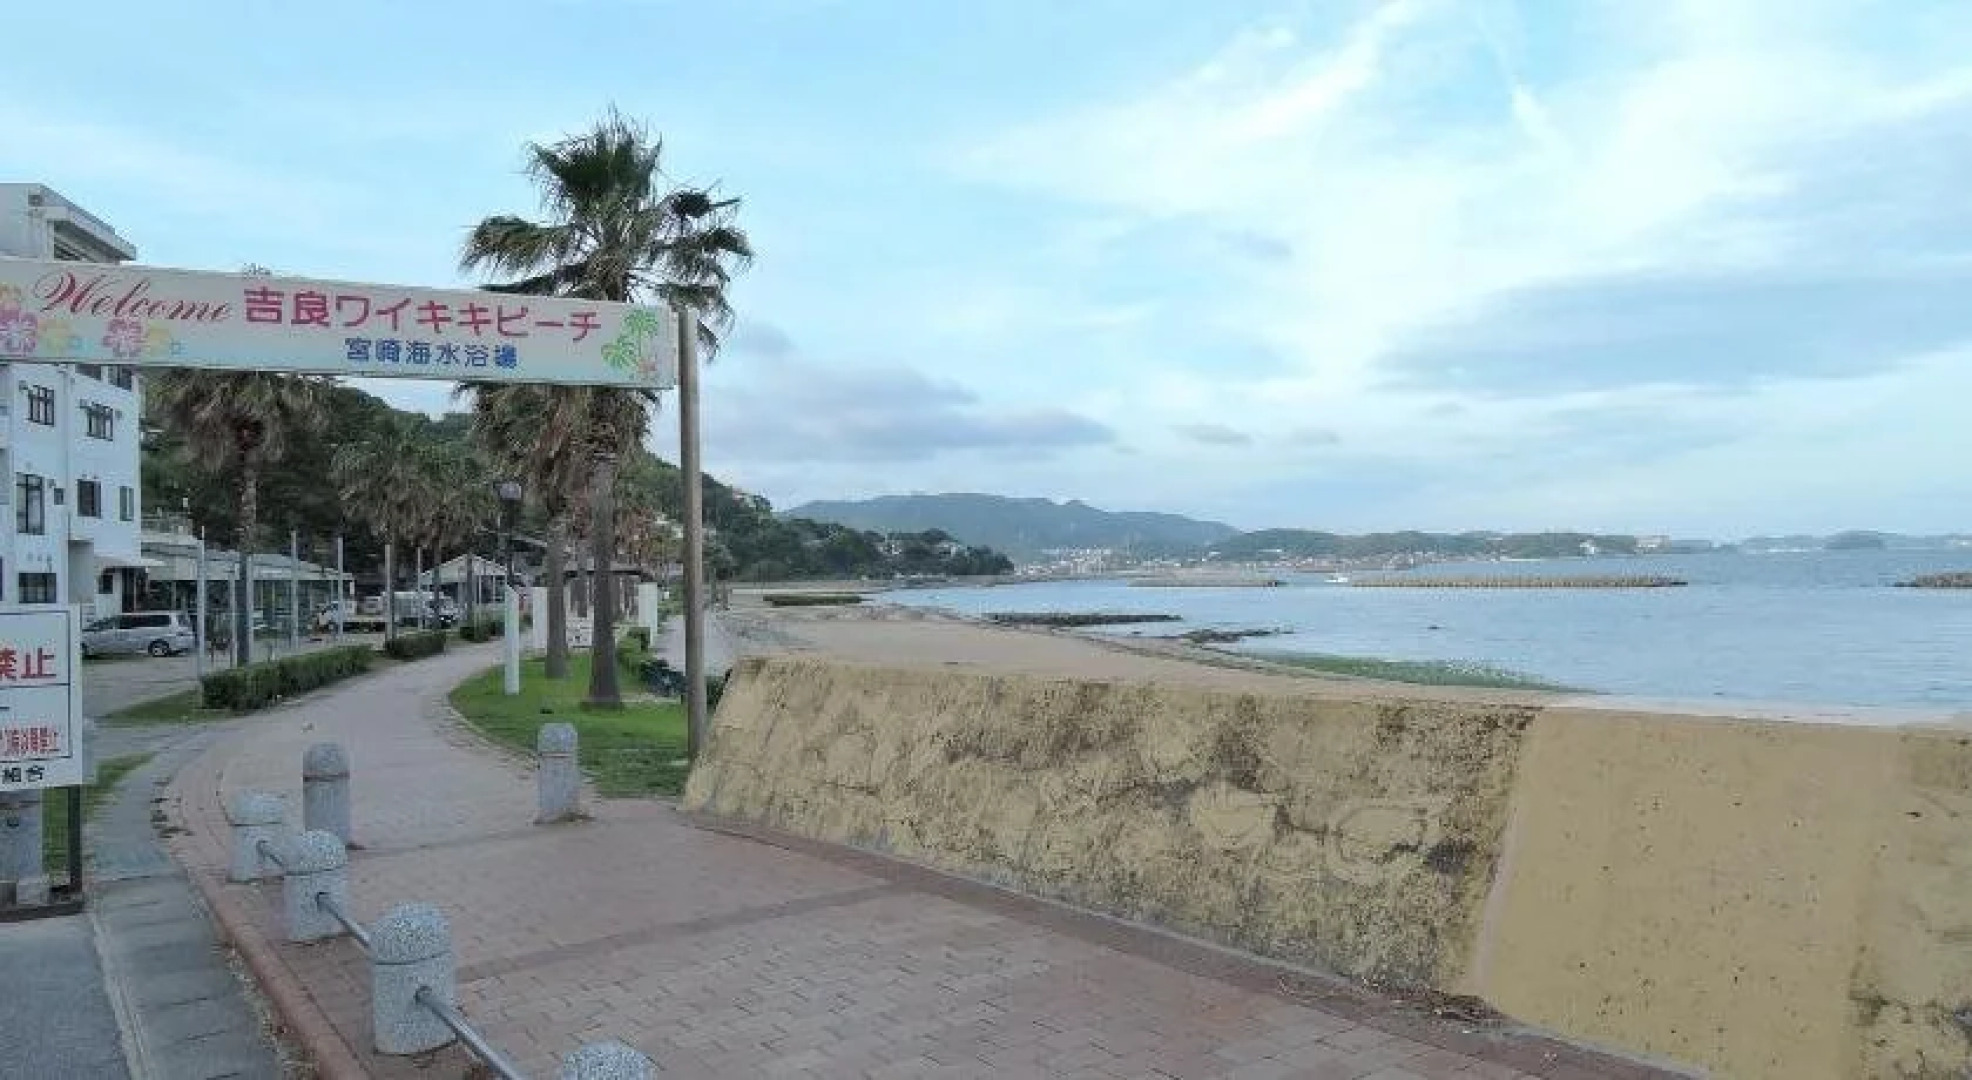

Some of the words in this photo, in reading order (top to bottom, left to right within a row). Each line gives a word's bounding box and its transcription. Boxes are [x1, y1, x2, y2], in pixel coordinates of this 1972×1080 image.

[33, 268, 232, 321] Welcome
[243, 286, 601, 342] 吉良ワイキキビーチ
